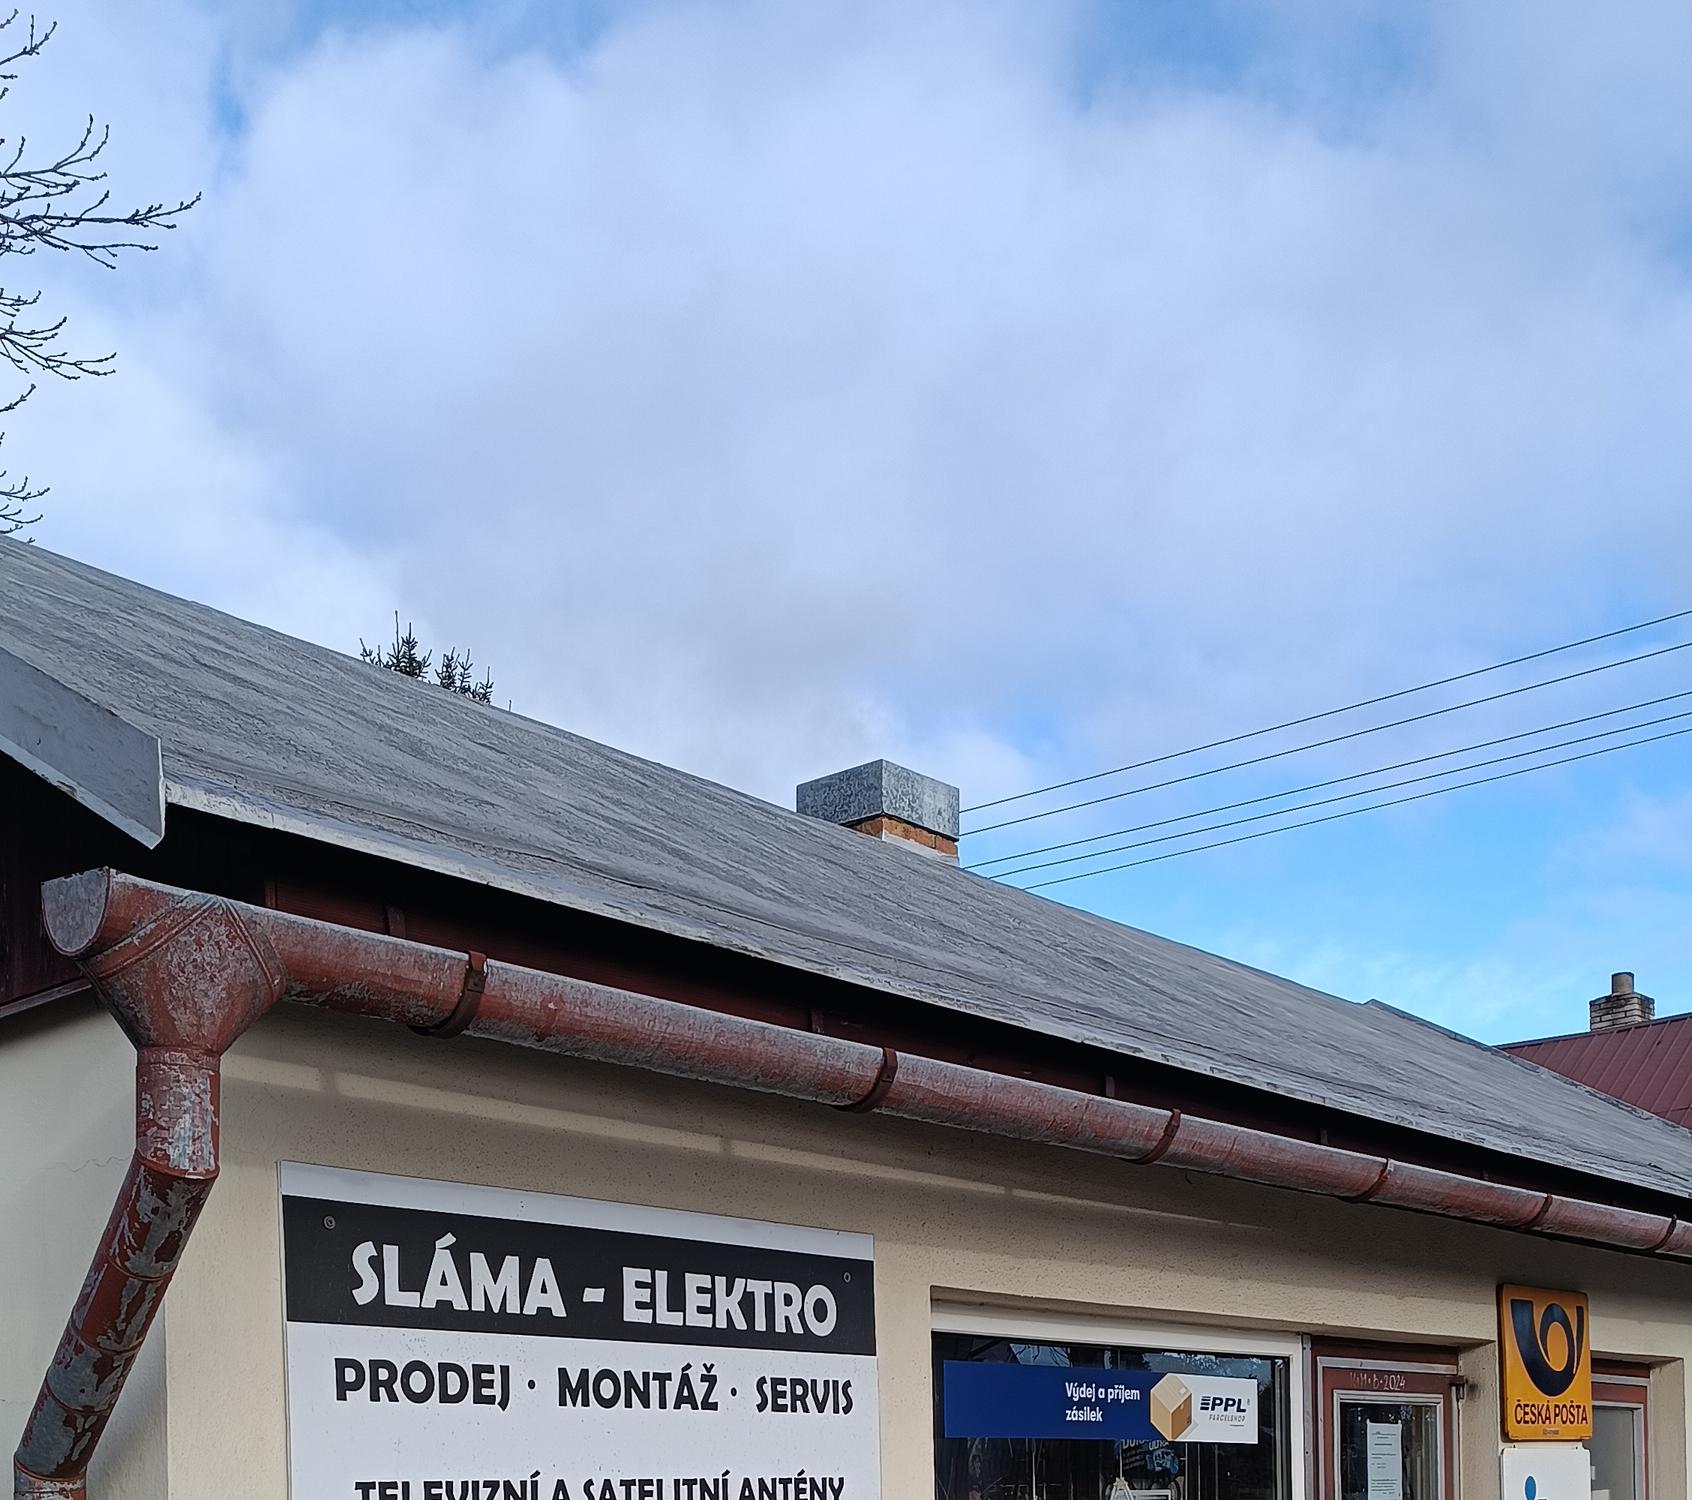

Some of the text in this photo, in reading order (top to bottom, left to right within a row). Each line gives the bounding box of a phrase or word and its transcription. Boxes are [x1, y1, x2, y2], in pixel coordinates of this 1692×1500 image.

[351, 1232, 567, 1318] SLÁMA
[622, 1266, 838, 1338] ELEKTRO
[334, 1357, 854, 1416] PRODEJ MONTÁŽ SERVIS
[1065, 1382, 1141, 1404] Výdej a příjem
[1065, 1406, 1103, 1422] zásilek
[1514, 1399, 1588, 1425] ČESKÁ POŠTA
